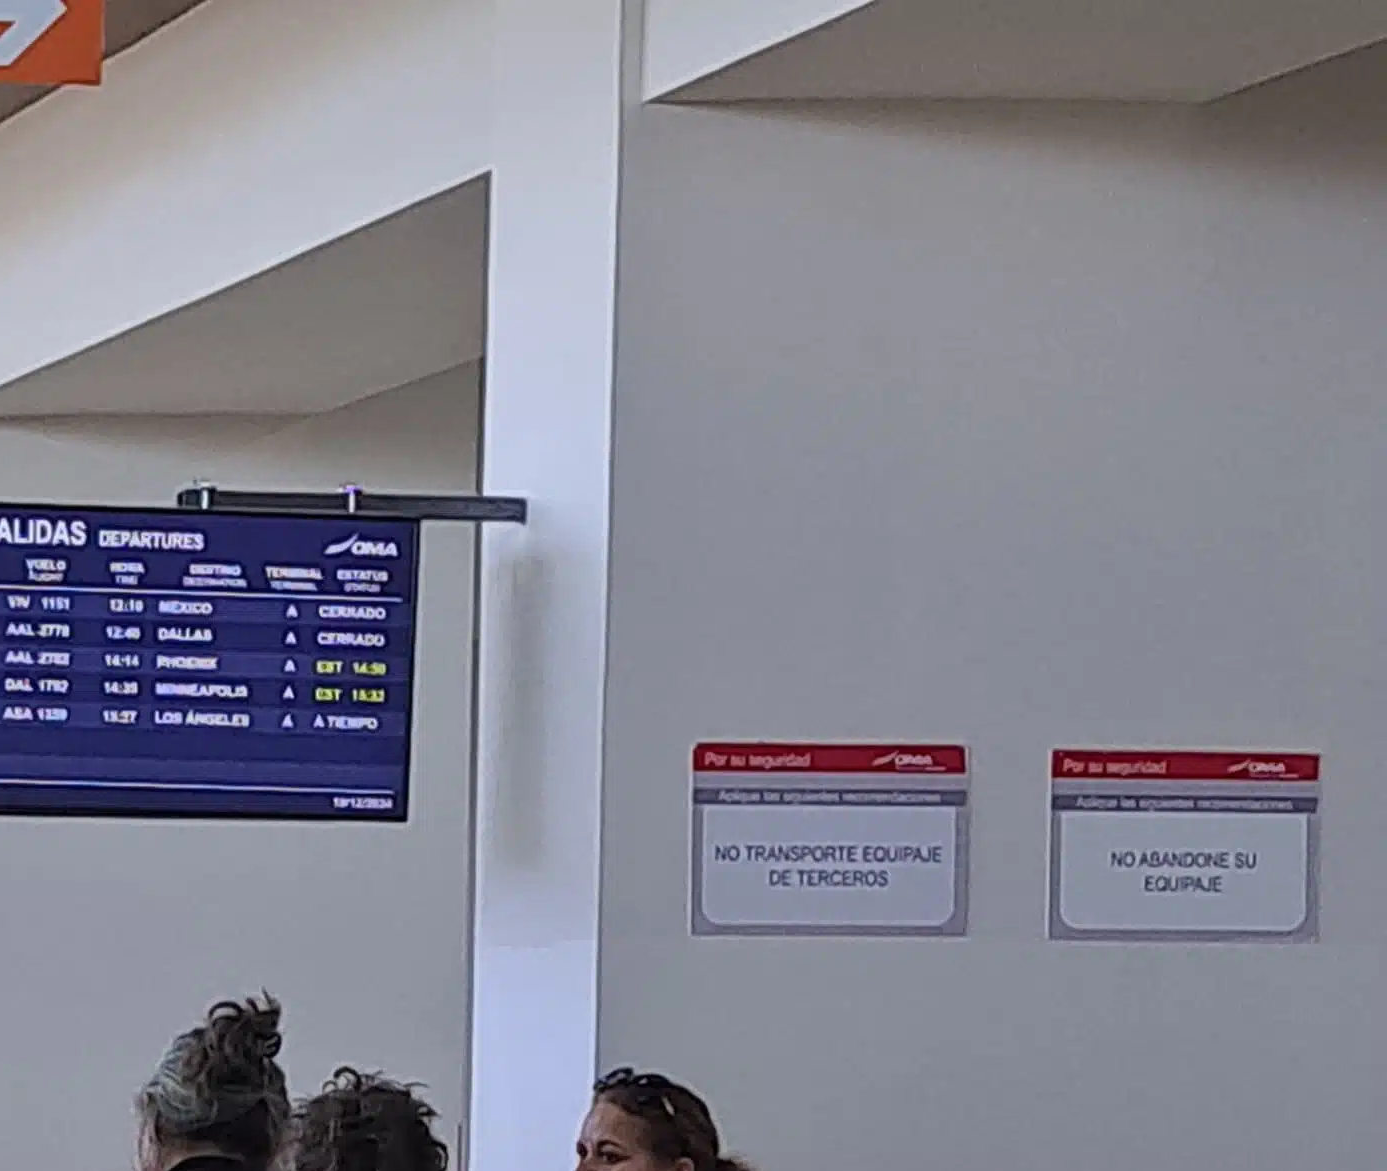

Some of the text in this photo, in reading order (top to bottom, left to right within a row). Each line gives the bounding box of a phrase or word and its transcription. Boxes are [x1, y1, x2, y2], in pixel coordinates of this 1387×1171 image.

[99, 530, 204, 550] DEPARTURES
[350, 542, 398, 557] OMA
[26, 559, 66, 571] VUELO
[286, 604, 298, 617] A
[318, 605, 386, 619] CERRADO
[285, 632, 296, 645] A
[317, 632, 385, 646] CERRADO
[284, 659, 296, 672] A
[283, 686, 294, 699] A
[154, 711, 182, 724] LOS
[282, 714, 293, 727] A
[313, 714, 325, 727] A
[704, 751, 811, 770] Por su seguridad
[1063, 758, 1167, 776] Por su seguridad
[714, 846, 942, 863] NO TRANSPORTE EQUIPAJE
[1110, 852, 1257, 869] NO ABANDONE SU
[768, 870, 889, 887] DE TERCEROS
[1144, 875, 1223, 892] EQUIPAJE
